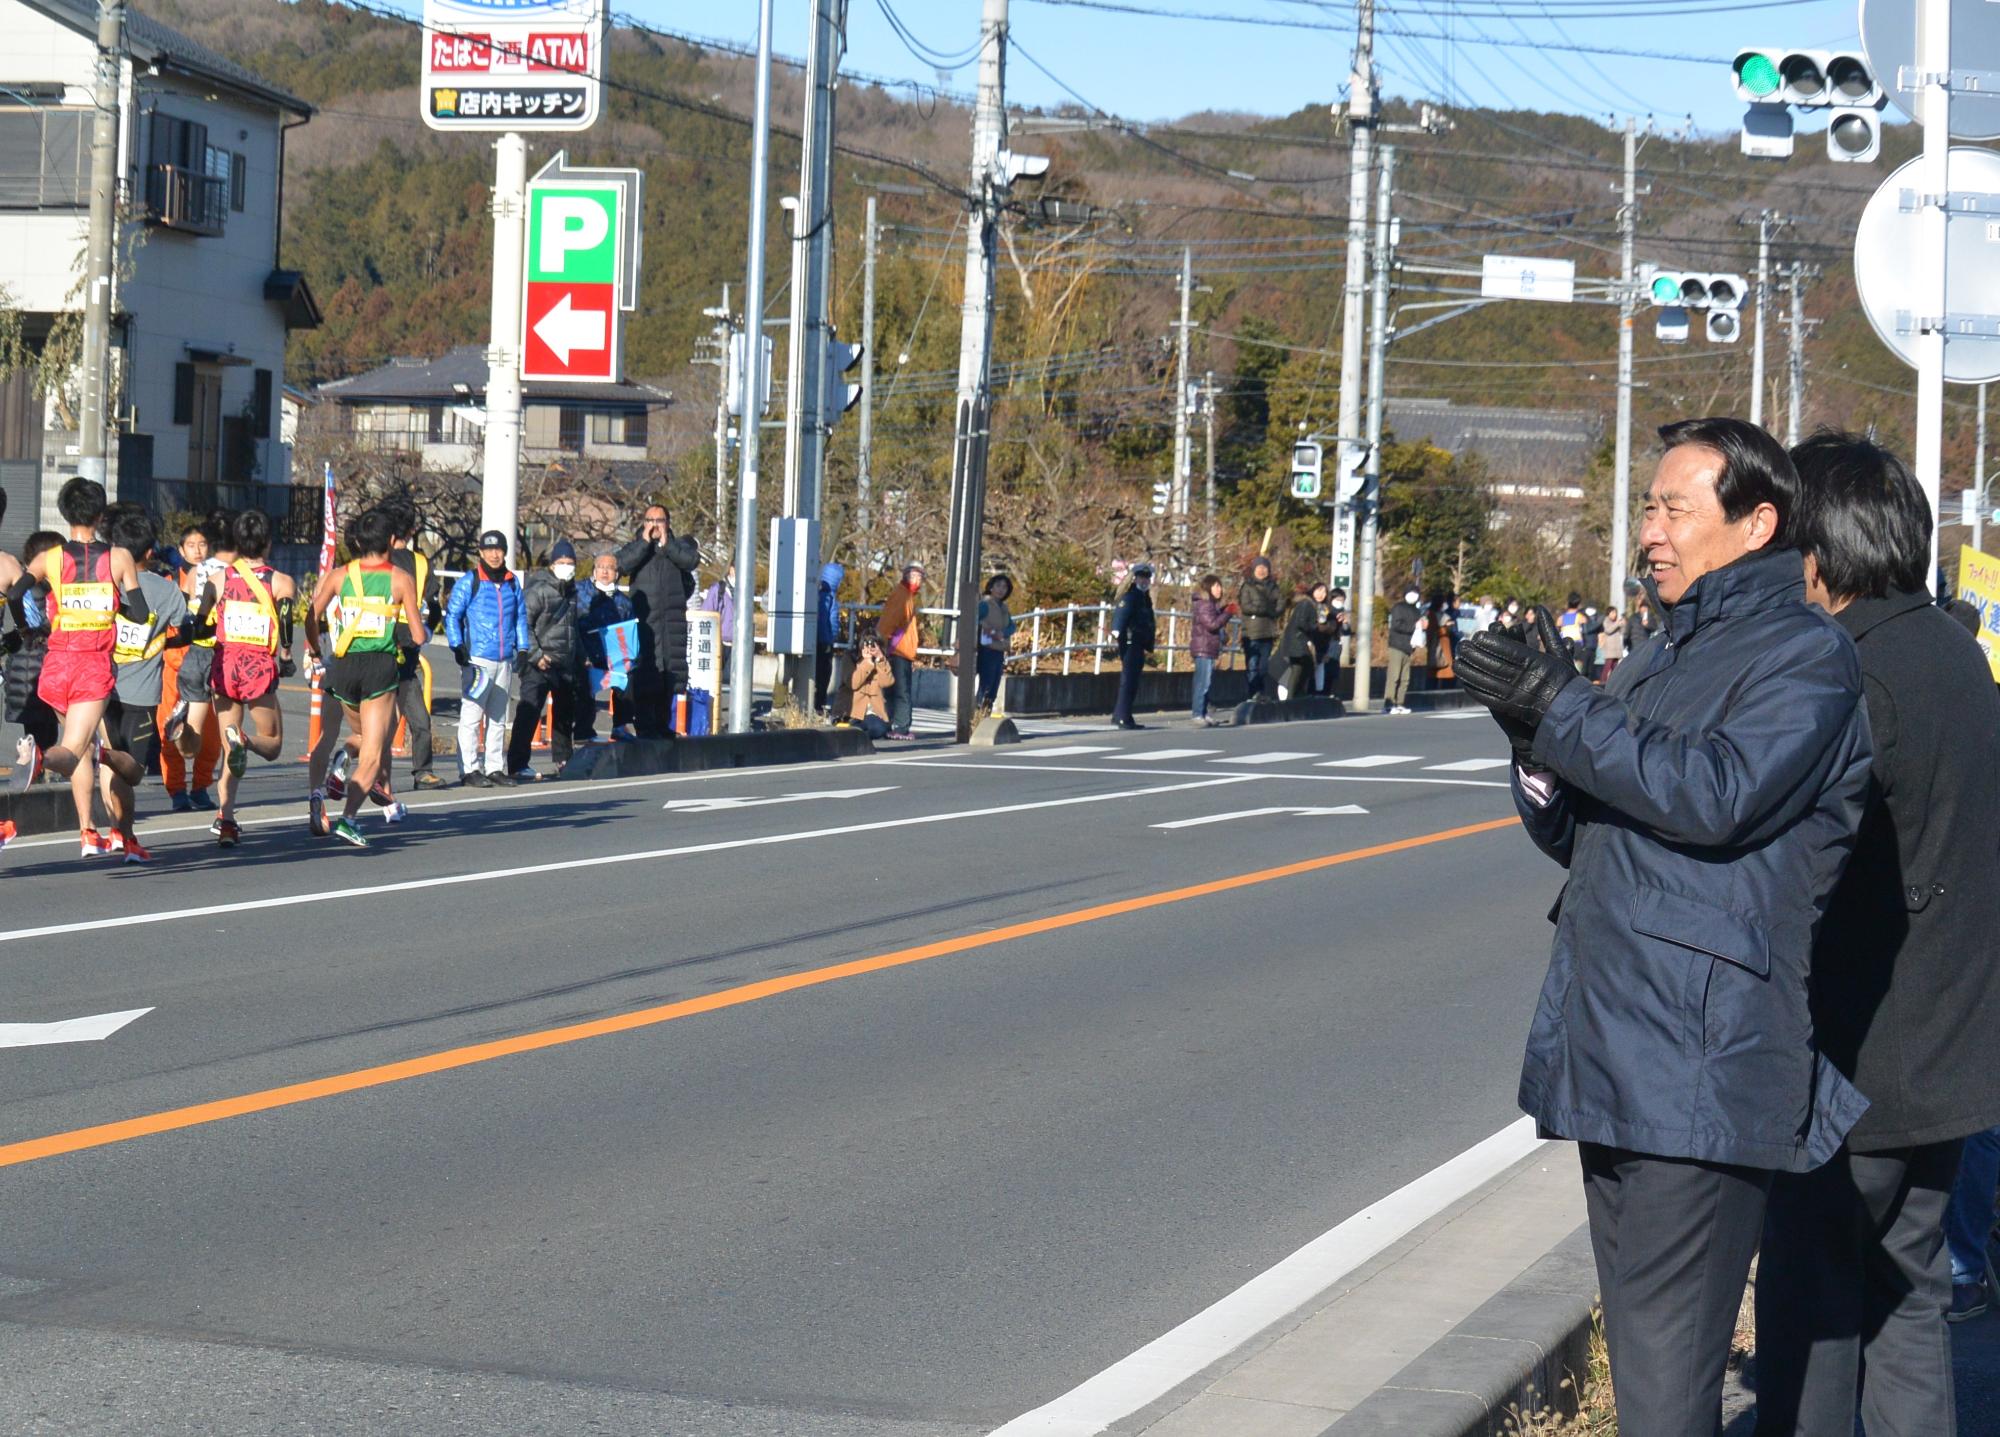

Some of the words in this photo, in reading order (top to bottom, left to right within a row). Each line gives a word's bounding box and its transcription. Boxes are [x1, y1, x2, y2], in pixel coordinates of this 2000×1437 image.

[434, 38, 489, 67] たばこ
[529, 38, 585, 66] ATM
[459, 91, 583, 115] 店内キッチン
[540, 197, 608, 273] P
[698, 620, 712, 672] 普通車
